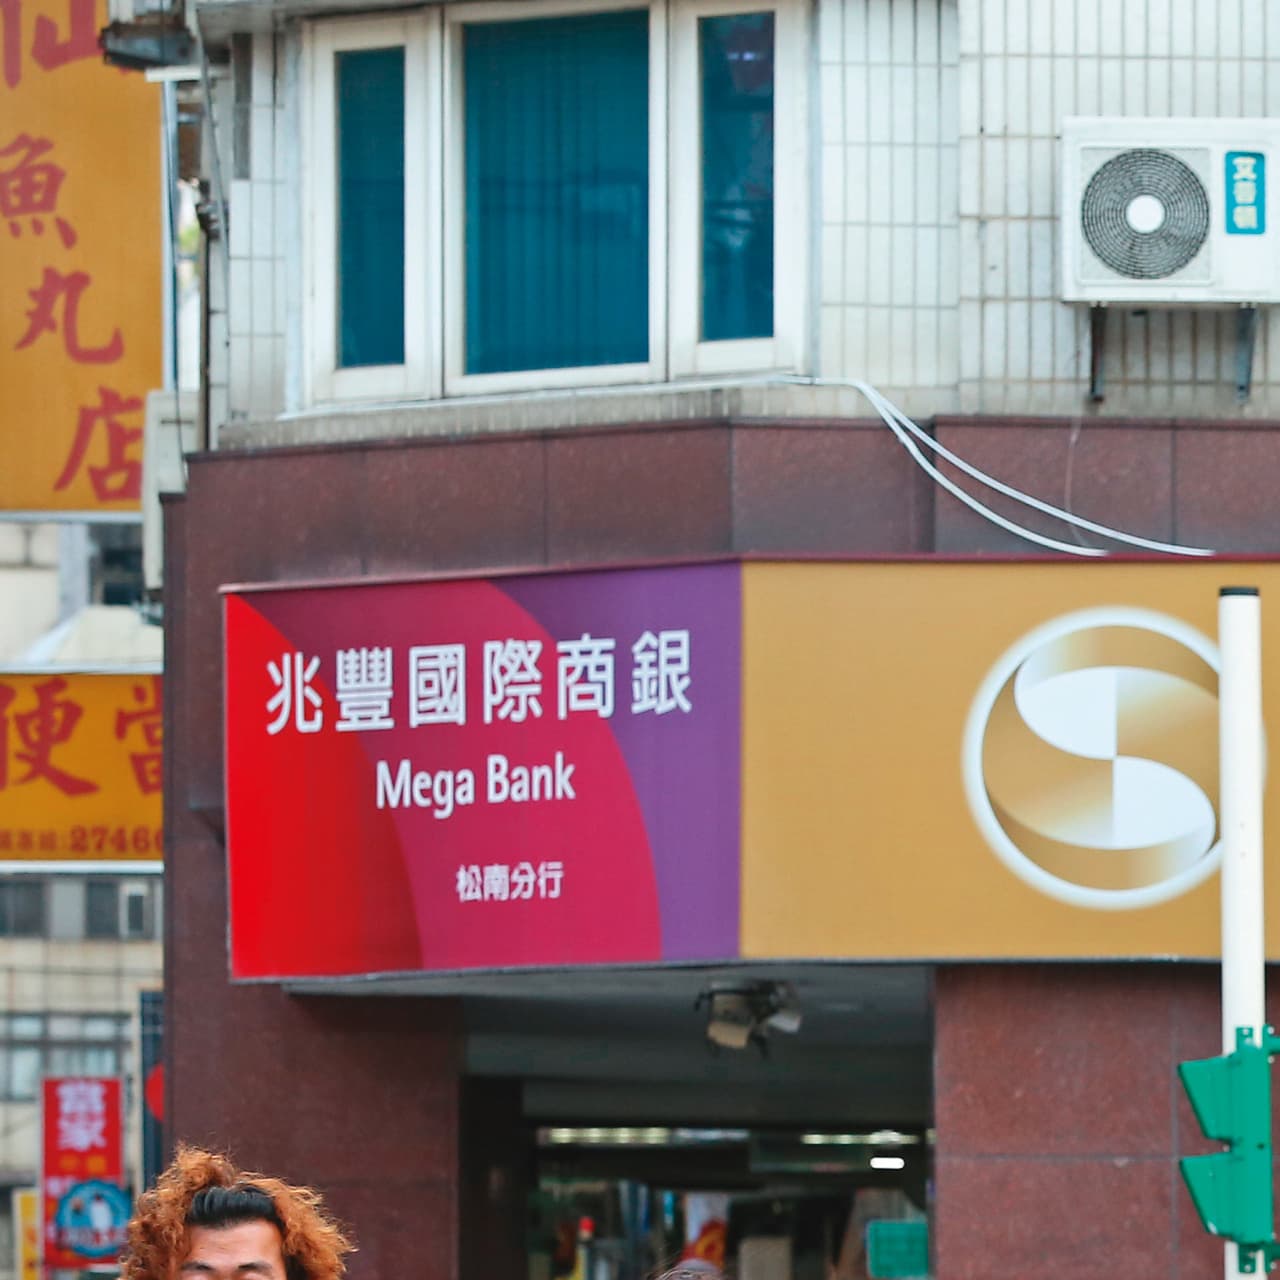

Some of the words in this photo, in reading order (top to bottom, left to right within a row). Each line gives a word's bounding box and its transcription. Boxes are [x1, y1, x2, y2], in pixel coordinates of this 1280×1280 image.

[265, 629, 693, 735] 兆豐國際商銀
[375, 759, 475, 819] Mega
[486, 751, 576, 804] Bank
[455, 860, 565, 902] 松南分行
